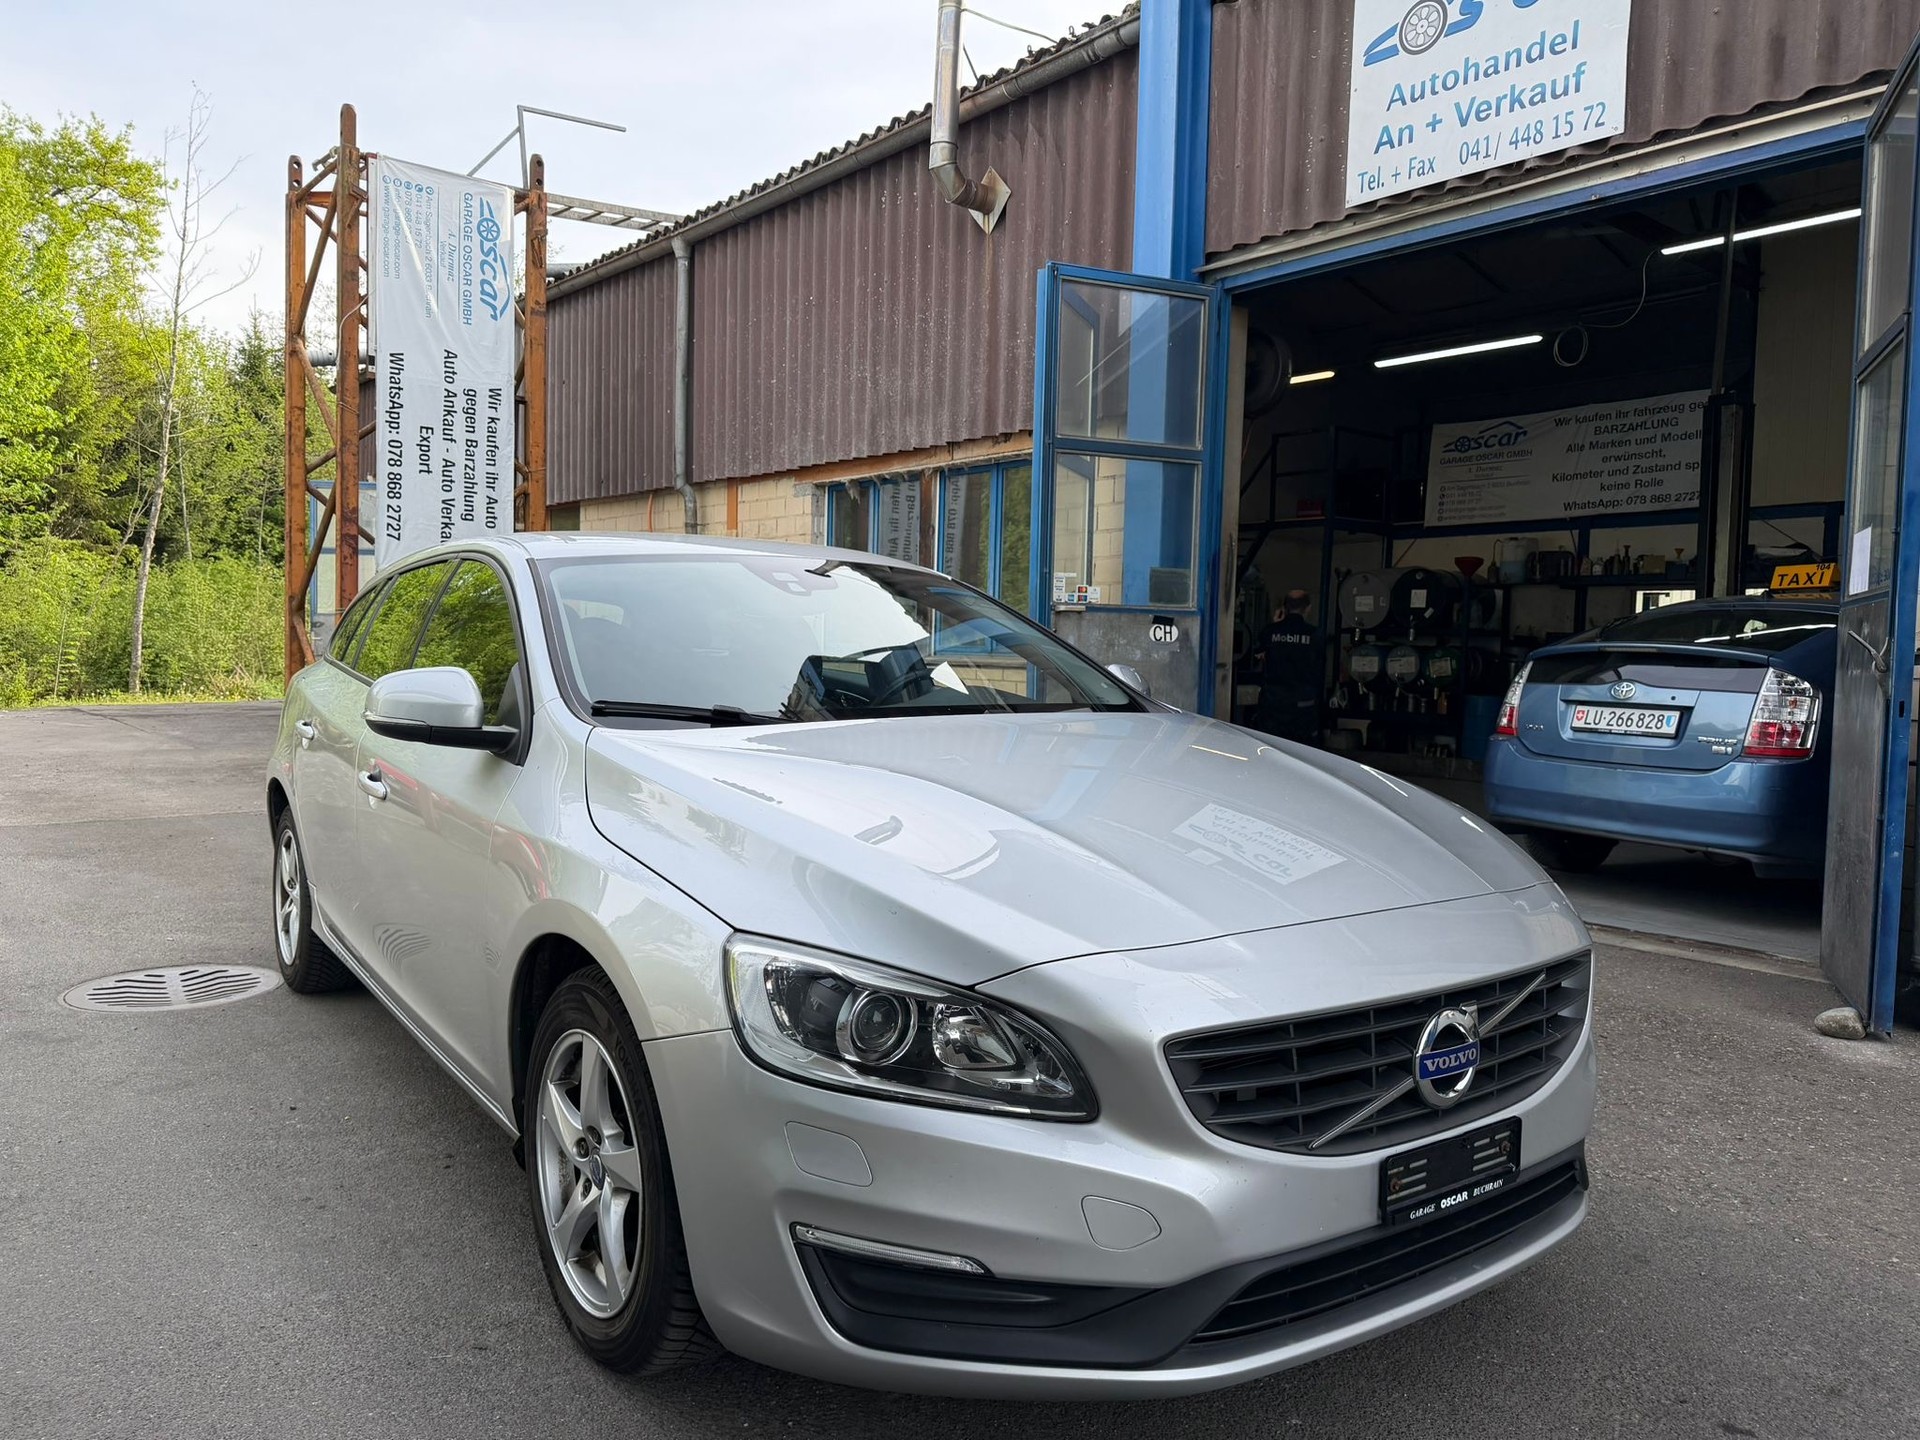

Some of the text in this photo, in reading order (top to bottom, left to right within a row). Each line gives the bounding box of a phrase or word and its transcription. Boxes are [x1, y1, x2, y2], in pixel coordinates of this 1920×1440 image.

[1386, 20, 1579, 112] Autohandel
[1374, 61, 1587, 154] An + Verkauf
[1358, 101, 1606, 193] Tel. + Fax 041/ 448 15 72
[383, 185, 391, 277] www.garage-oscar.com
[415, 227, 422, 237] 15
[415, 239, 422, 248] 72
[448, 243, 456, 282] Durmaz
[462, 193, 472, 325] GARAGE OSCAR GMBH
[444, 349, 458, 384] Auto
[442, 389, 457, 444] Ankauf
[1554, 417, 1572, 426] Wir
[1575, 411, 1611, 424] kaufen
[1615, 410, 1629, 420] ihr
[1634, 404, 1684, 417] fahrzeug
[1594, 417, 1679, 435] BARZAHLUNG
[385, 353, 404, 541] WhatsApp: 078 868 2727
[416, 426, 434, 474] Export
[461, 388, 479, 522] gegen Barzahlung
[1440, 450, 1532, 465] GARAGE OSCAR GMBH
[1566, 443, 1585, 453] Alle
[1589, 439, 1631, 450] Marken
[1635, 435, 1656, 445] und
[1602, 449, 1665, 463] erwünscht,
[486, 388, 502, 529] Wir kaufen ihr Auto
[1552, 469, 1604, 482] Kilometer
[1608, 467, 1629, 477] und
[1633, 462, 1681, 474] Zustand
[442, 459, 456, 492] Auto
[1600, 478, 1663, 491] keine Rolle
[1563, 498, 1623, 512] WhatsApp:
[1626, 495, 1646, 505] 078
[1650, 493, 1671, 503] 868
[1778, 571, 1824, 586] TAXI
[1153, 625, 1174, 642] CH
[1272, 633, 1299, 643] Mobil
[1424, 1048, 1477, 1072] VOLVO
[1410, 1179, 1504, 1219] GARAGE OSCAR BUCHRAIN
